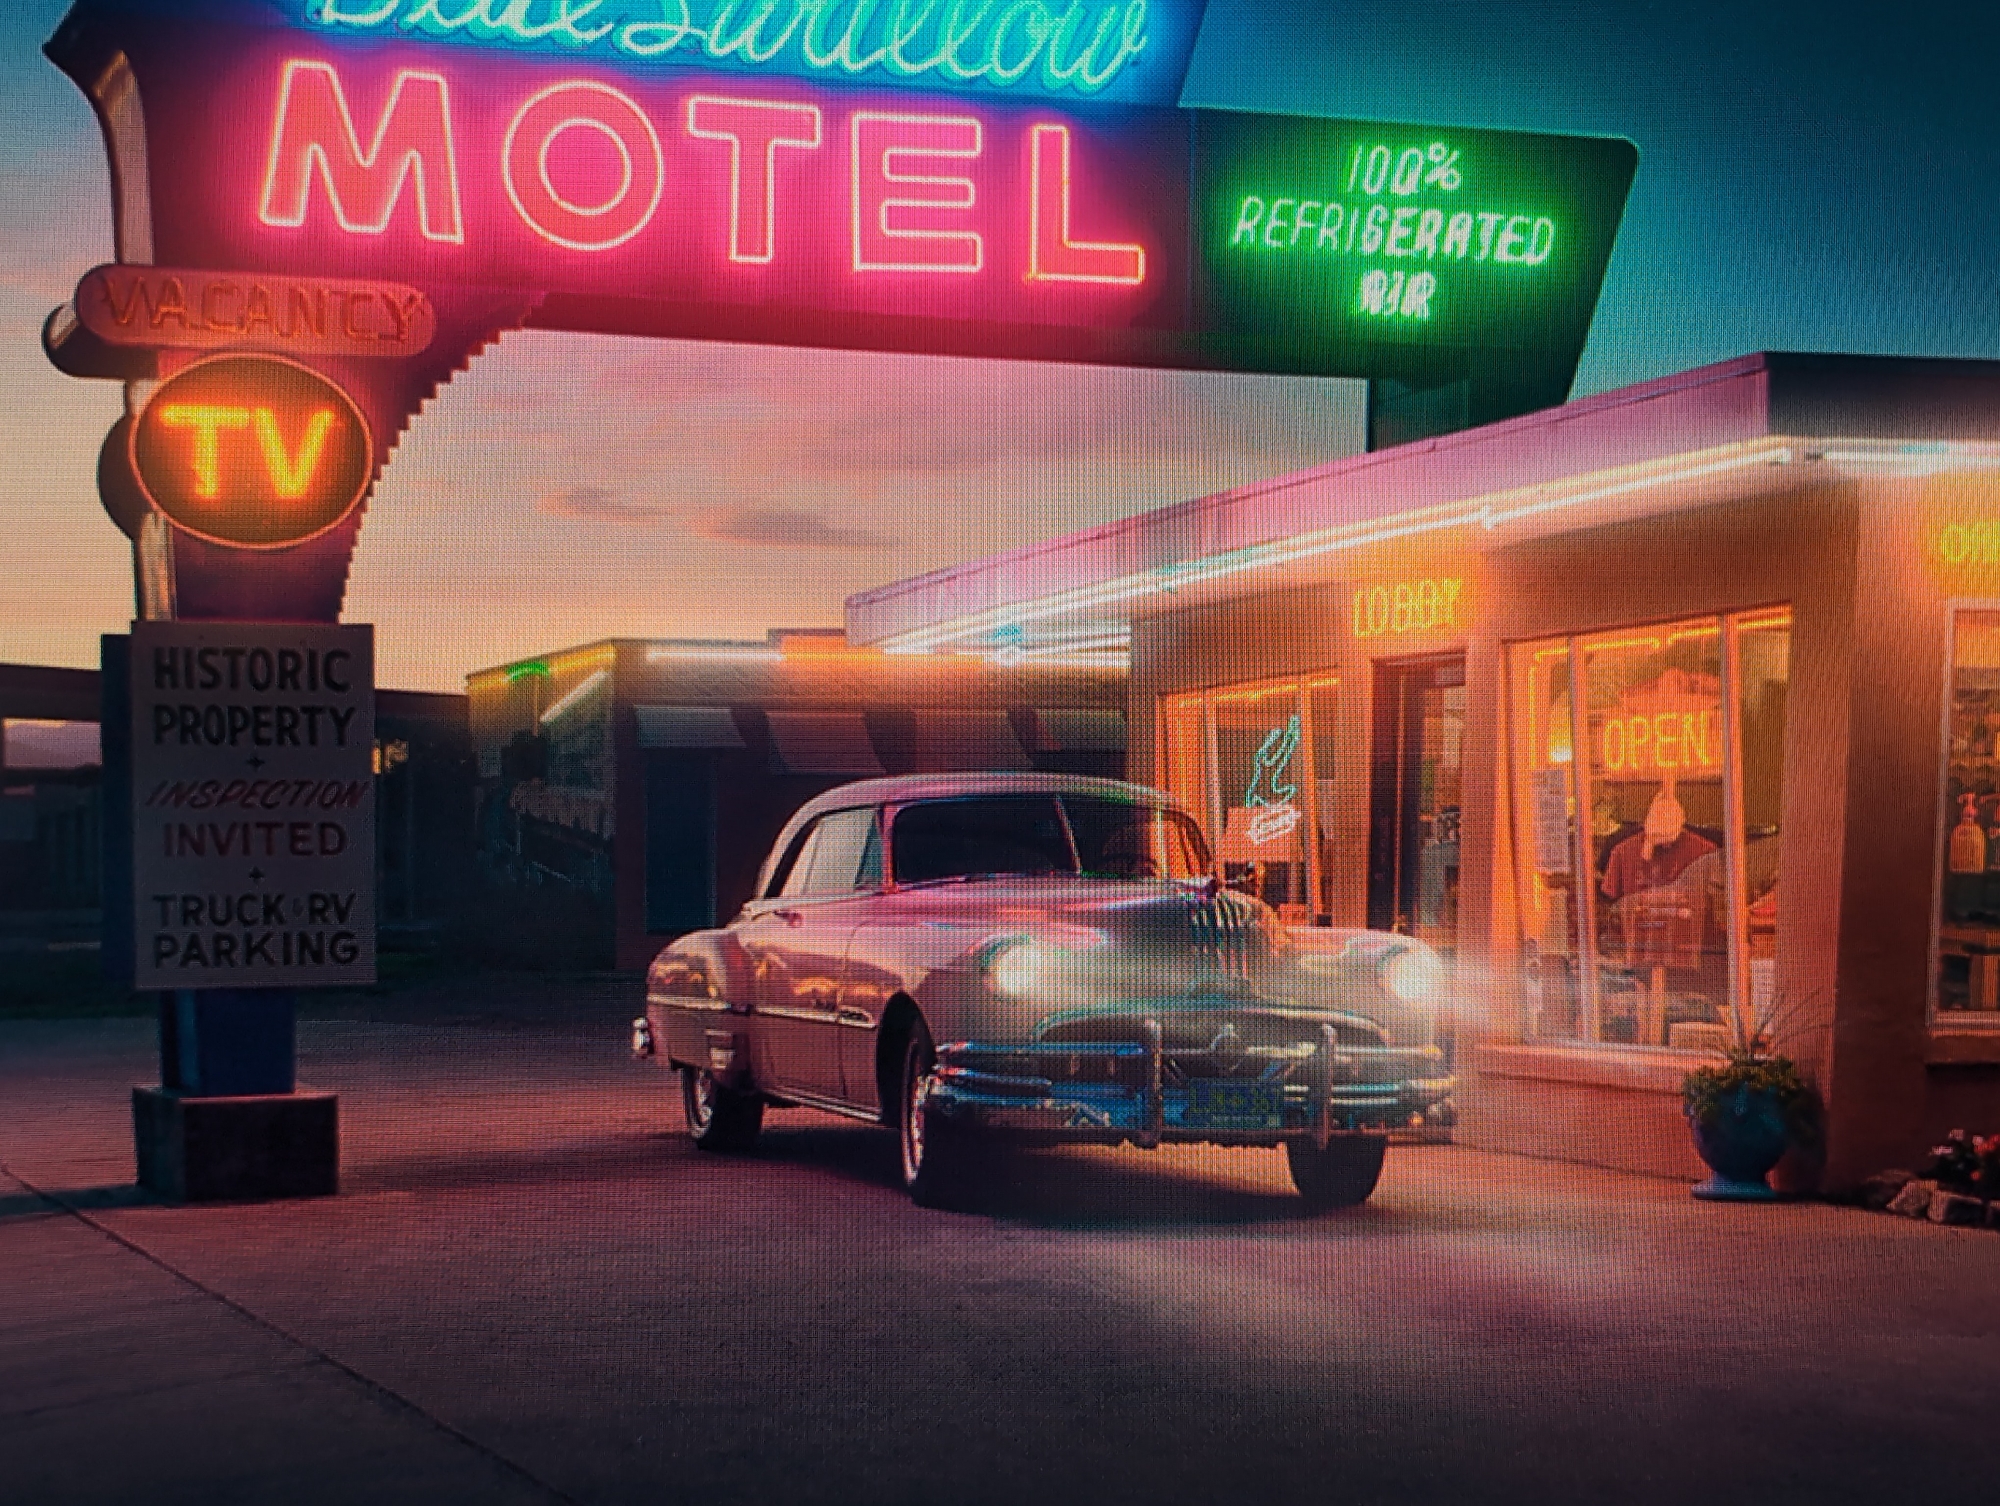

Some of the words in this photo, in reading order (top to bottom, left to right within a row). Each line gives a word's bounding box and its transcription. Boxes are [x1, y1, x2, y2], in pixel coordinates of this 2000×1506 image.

[257, 58, 1146, 286] MOTEL
[1346, 141, 1462, 196] 100%
[1231, 195, 1556, 266] REFRIGERATED
[103, 275, 426, 345] VACANCY
[1359, 269, 1437, 320] AIR
[160, 404, 334, 498] TV
[1353, 577, 1461, 637] LOBBY
[154, 646, 351, 692] HISTORIC
[153, 705, 355, 747] PROPERTY
[1604, 710, 1710, 771] OPEN
[147, 779, 368, 809] INSPECTION
[163, 822, 346, 857] INVITED
[152, 893, 286, 927] TRUCK
[307, 892, 357, 925] RV
[154, 931, 359, 968] PARKING
